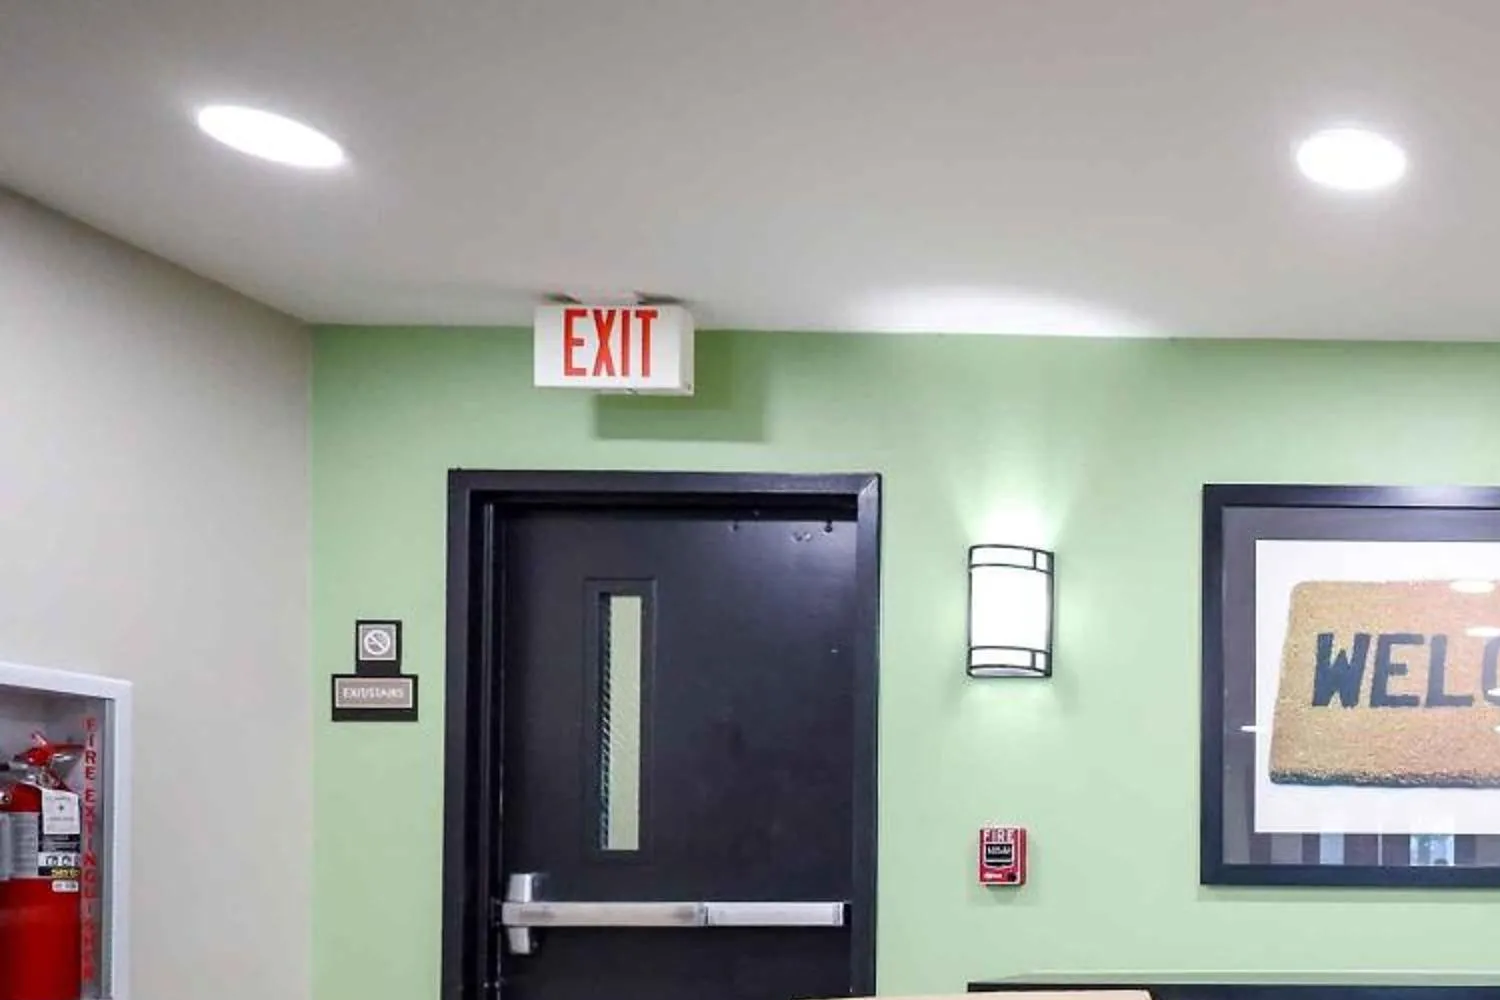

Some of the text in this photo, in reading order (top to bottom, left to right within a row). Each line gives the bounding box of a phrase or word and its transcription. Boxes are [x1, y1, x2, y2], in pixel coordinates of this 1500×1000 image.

[563, 309, 659, 377] EXIT
[84, 717, 97, 781] FIRE
[983, 828, 1015, 843] FIRE
